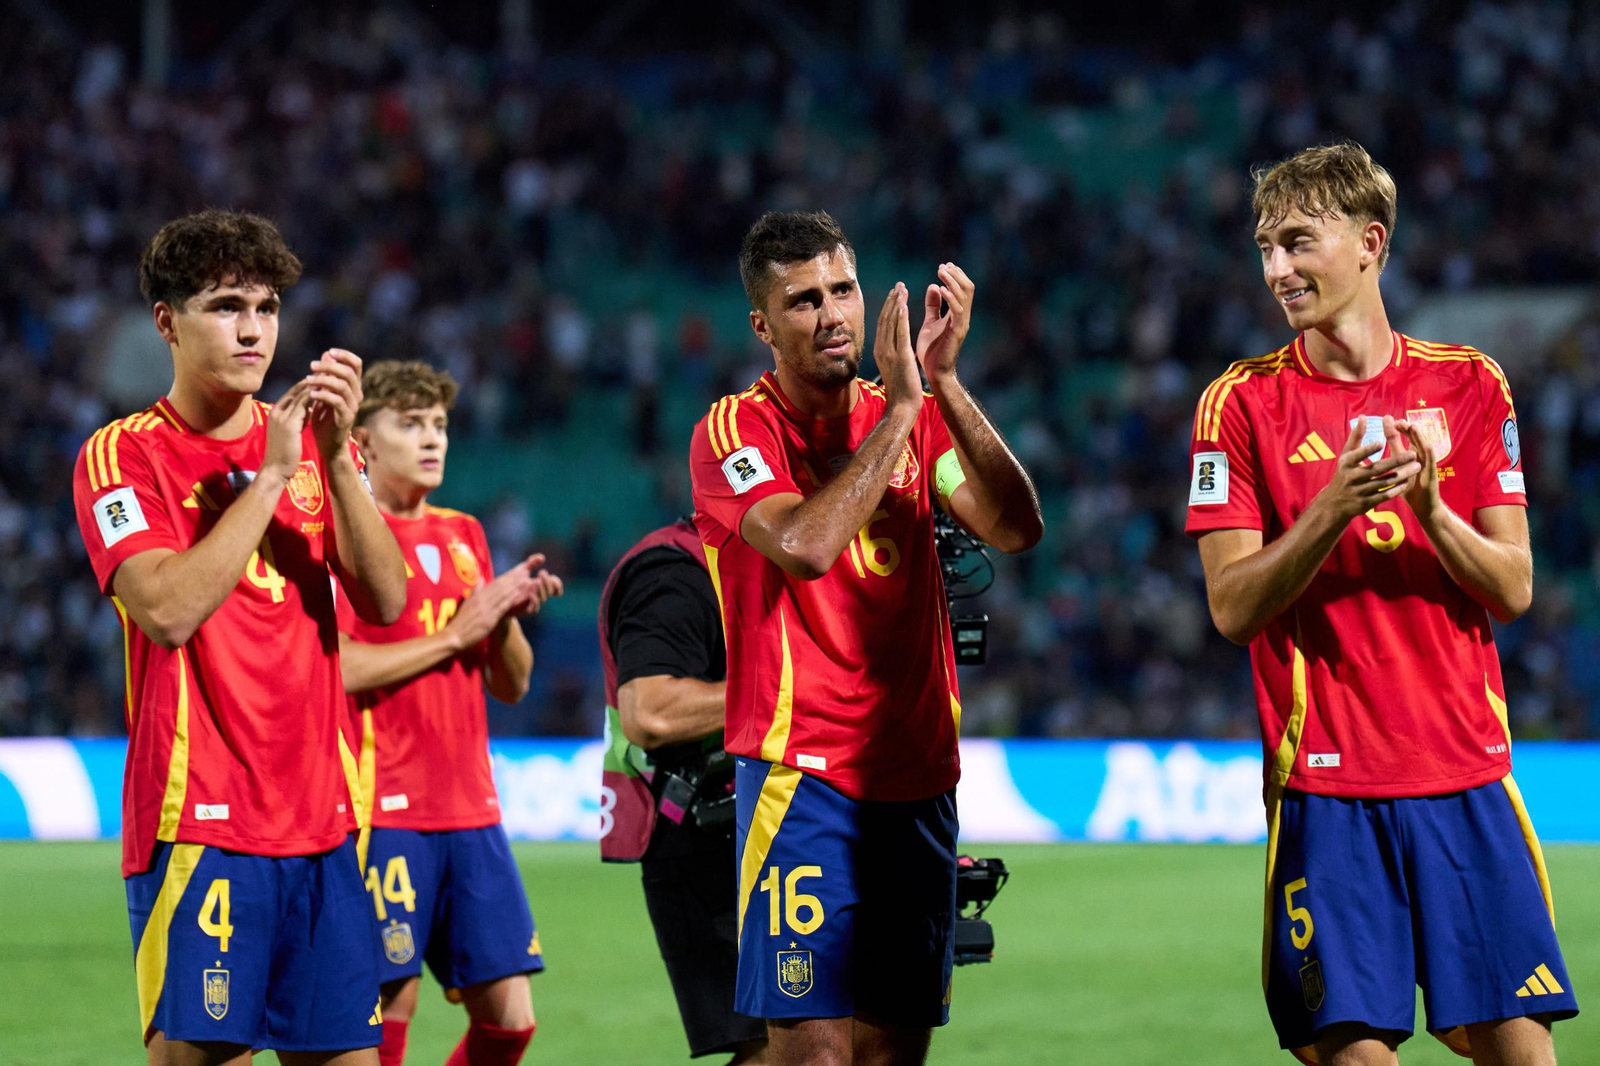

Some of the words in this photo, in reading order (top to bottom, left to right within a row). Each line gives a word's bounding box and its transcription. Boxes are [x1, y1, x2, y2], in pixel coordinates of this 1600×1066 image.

[1365, 508, 1406, 553] 5
[245, 534, 287, 603] 4
[197, 878, 234, 953] 4
[364, 855, 417, 922] 14
[760, 865, 825, 936] 16
[1284, 877, 1315, 951] 5
